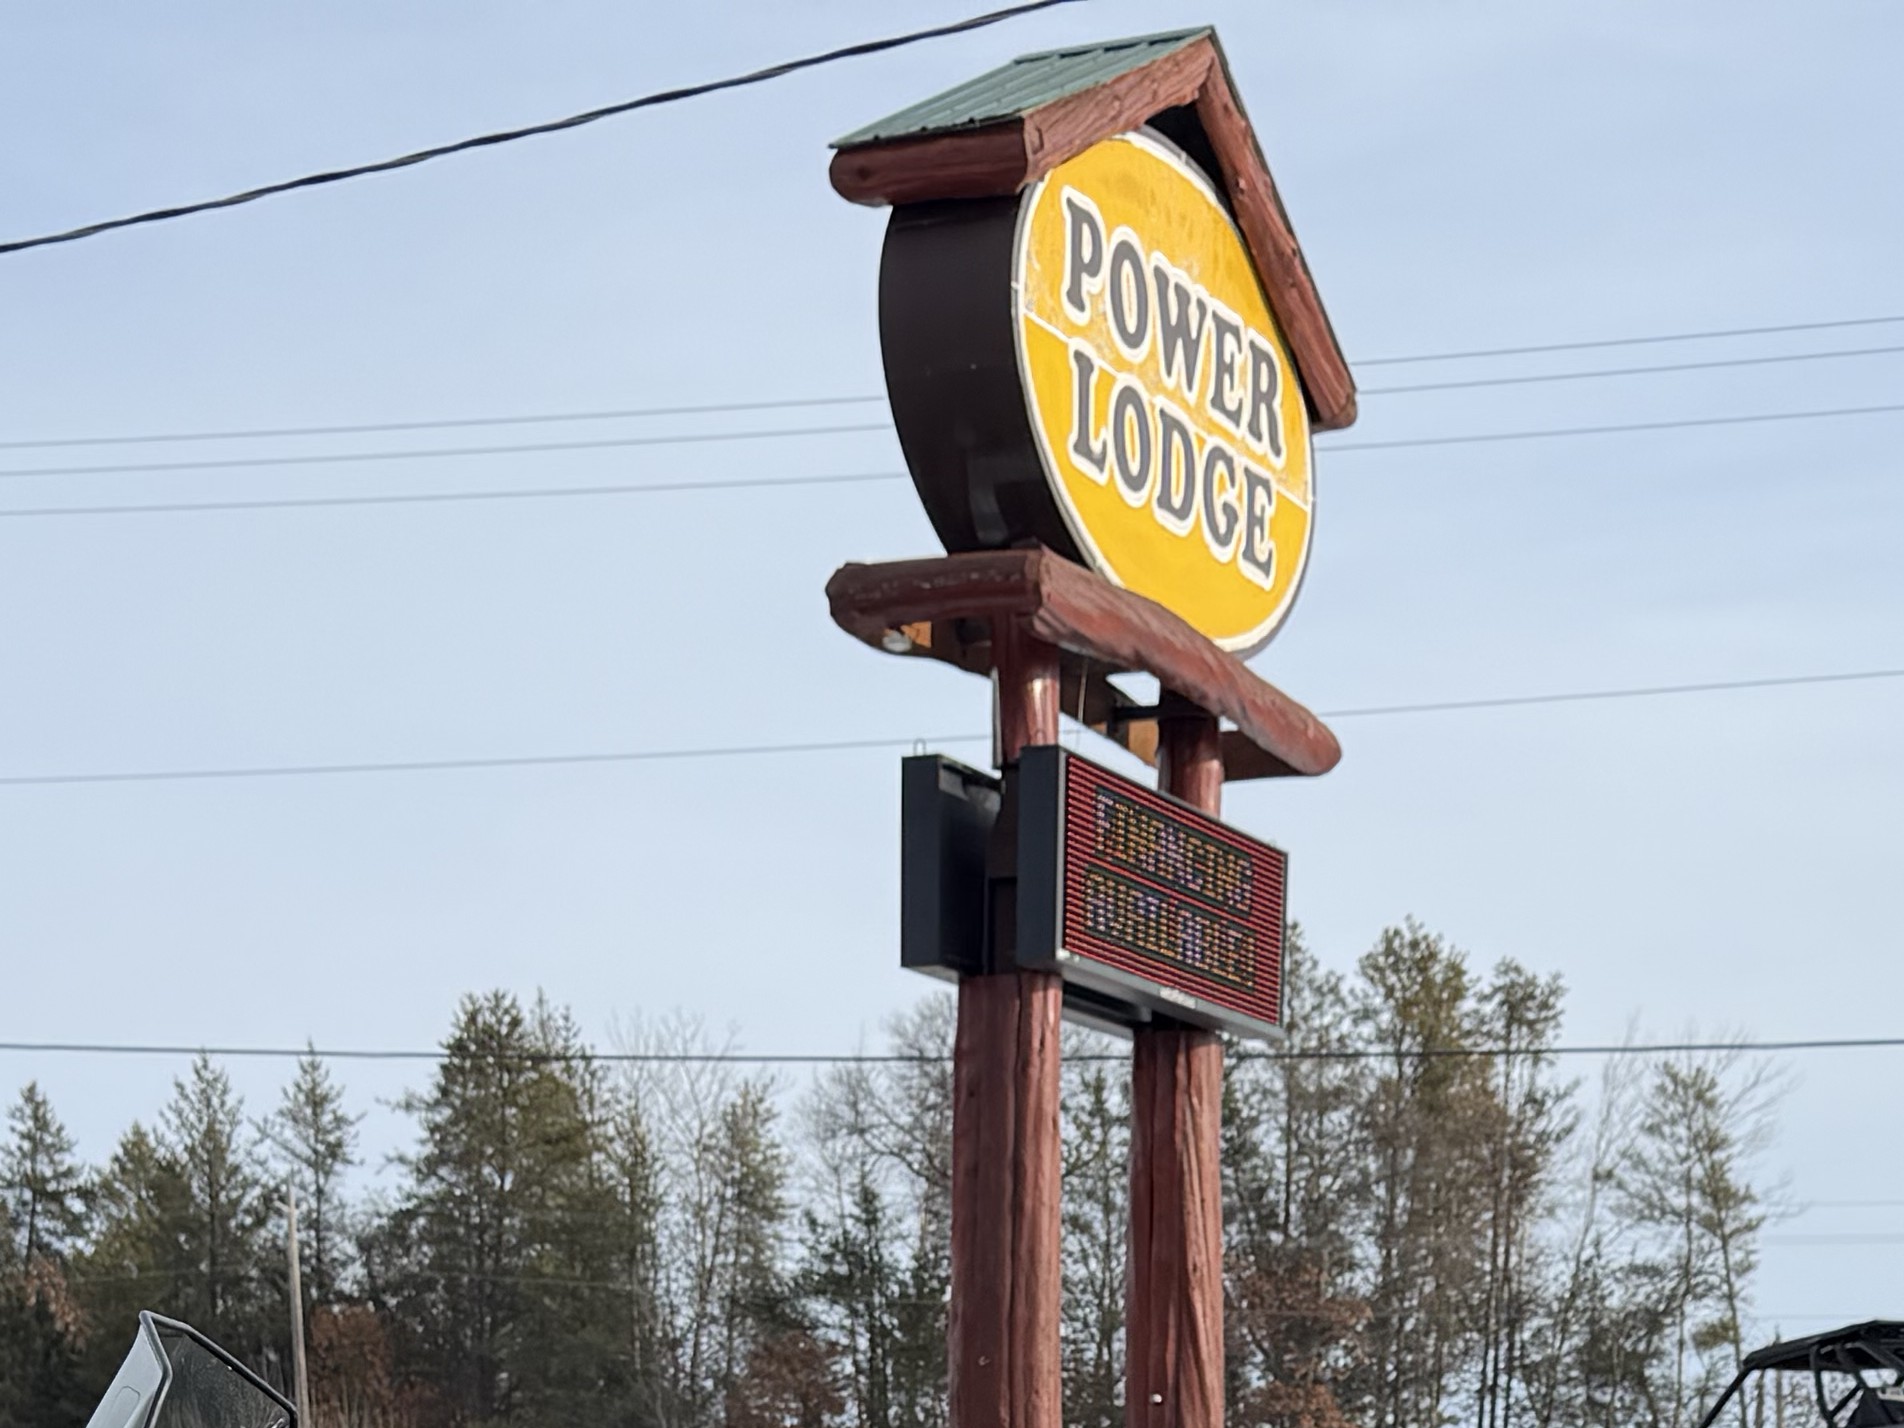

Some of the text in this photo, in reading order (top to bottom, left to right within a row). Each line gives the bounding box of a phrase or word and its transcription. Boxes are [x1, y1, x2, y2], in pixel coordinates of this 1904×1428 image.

[1065, 192, 1284, 463] POWER
[1070, 345, 1275, 584] LODGE
[1096, 794, 1252, 913] FINANCING
